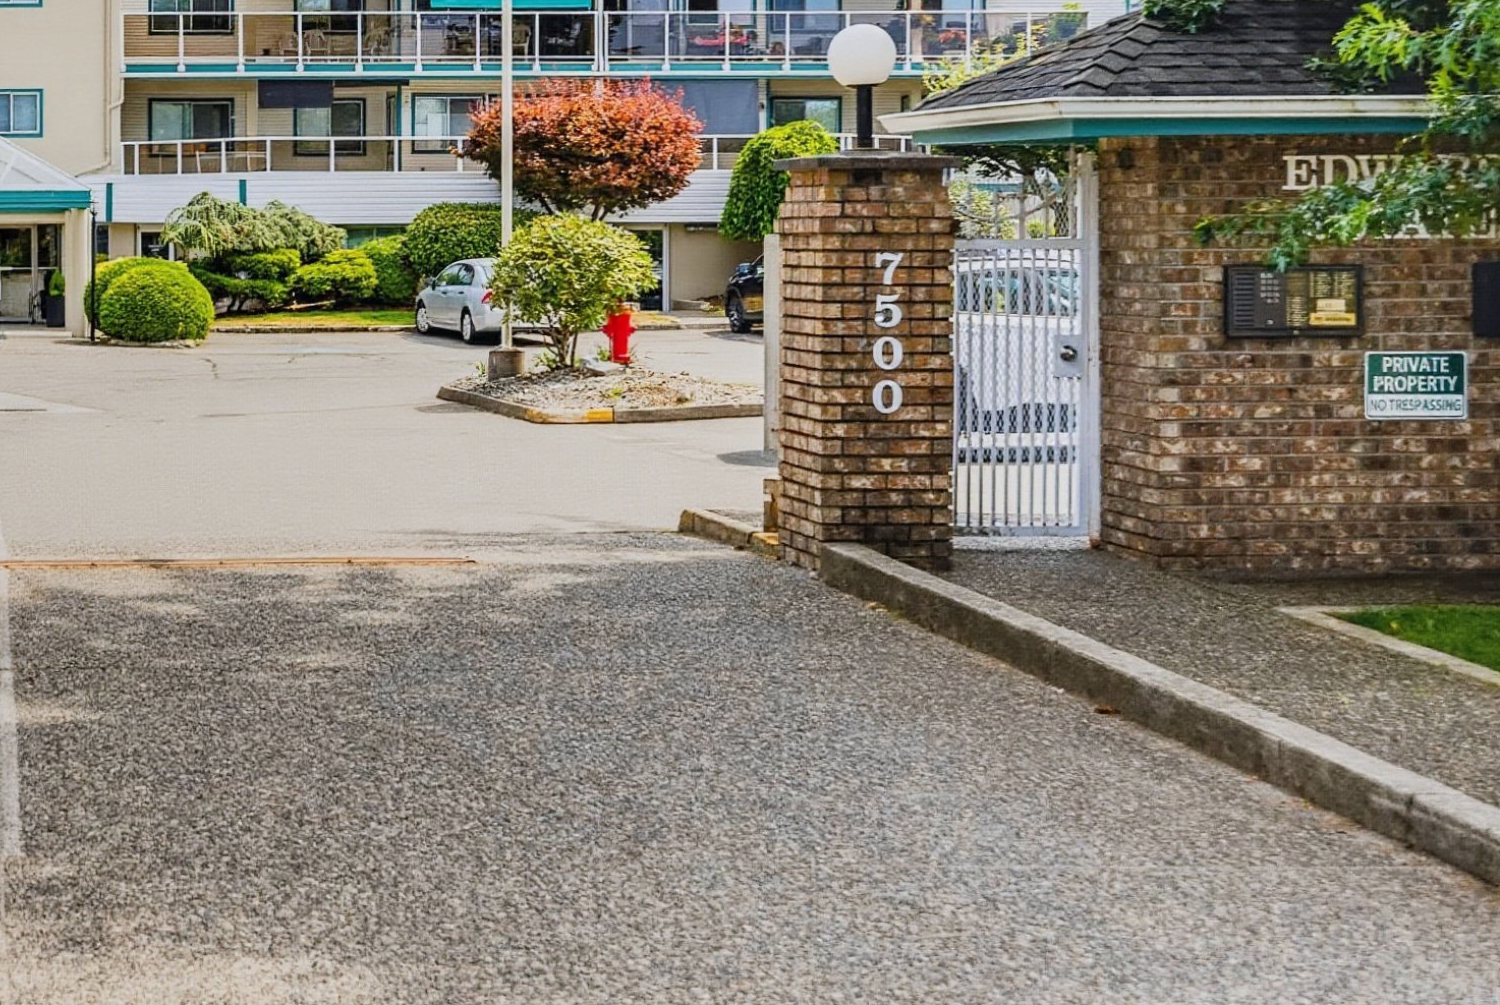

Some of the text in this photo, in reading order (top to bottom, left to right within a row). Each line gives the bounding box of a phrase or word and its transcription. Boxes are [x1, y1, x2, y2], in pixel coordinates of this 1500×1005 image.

[872, 252, 904, 414] 7500
[1382, 356, 1450, 373] PRIVATE
[1373, 376, 1458, 392] PROPERTY
[1371, 399, 1461, 411] NO TRESPASSING
